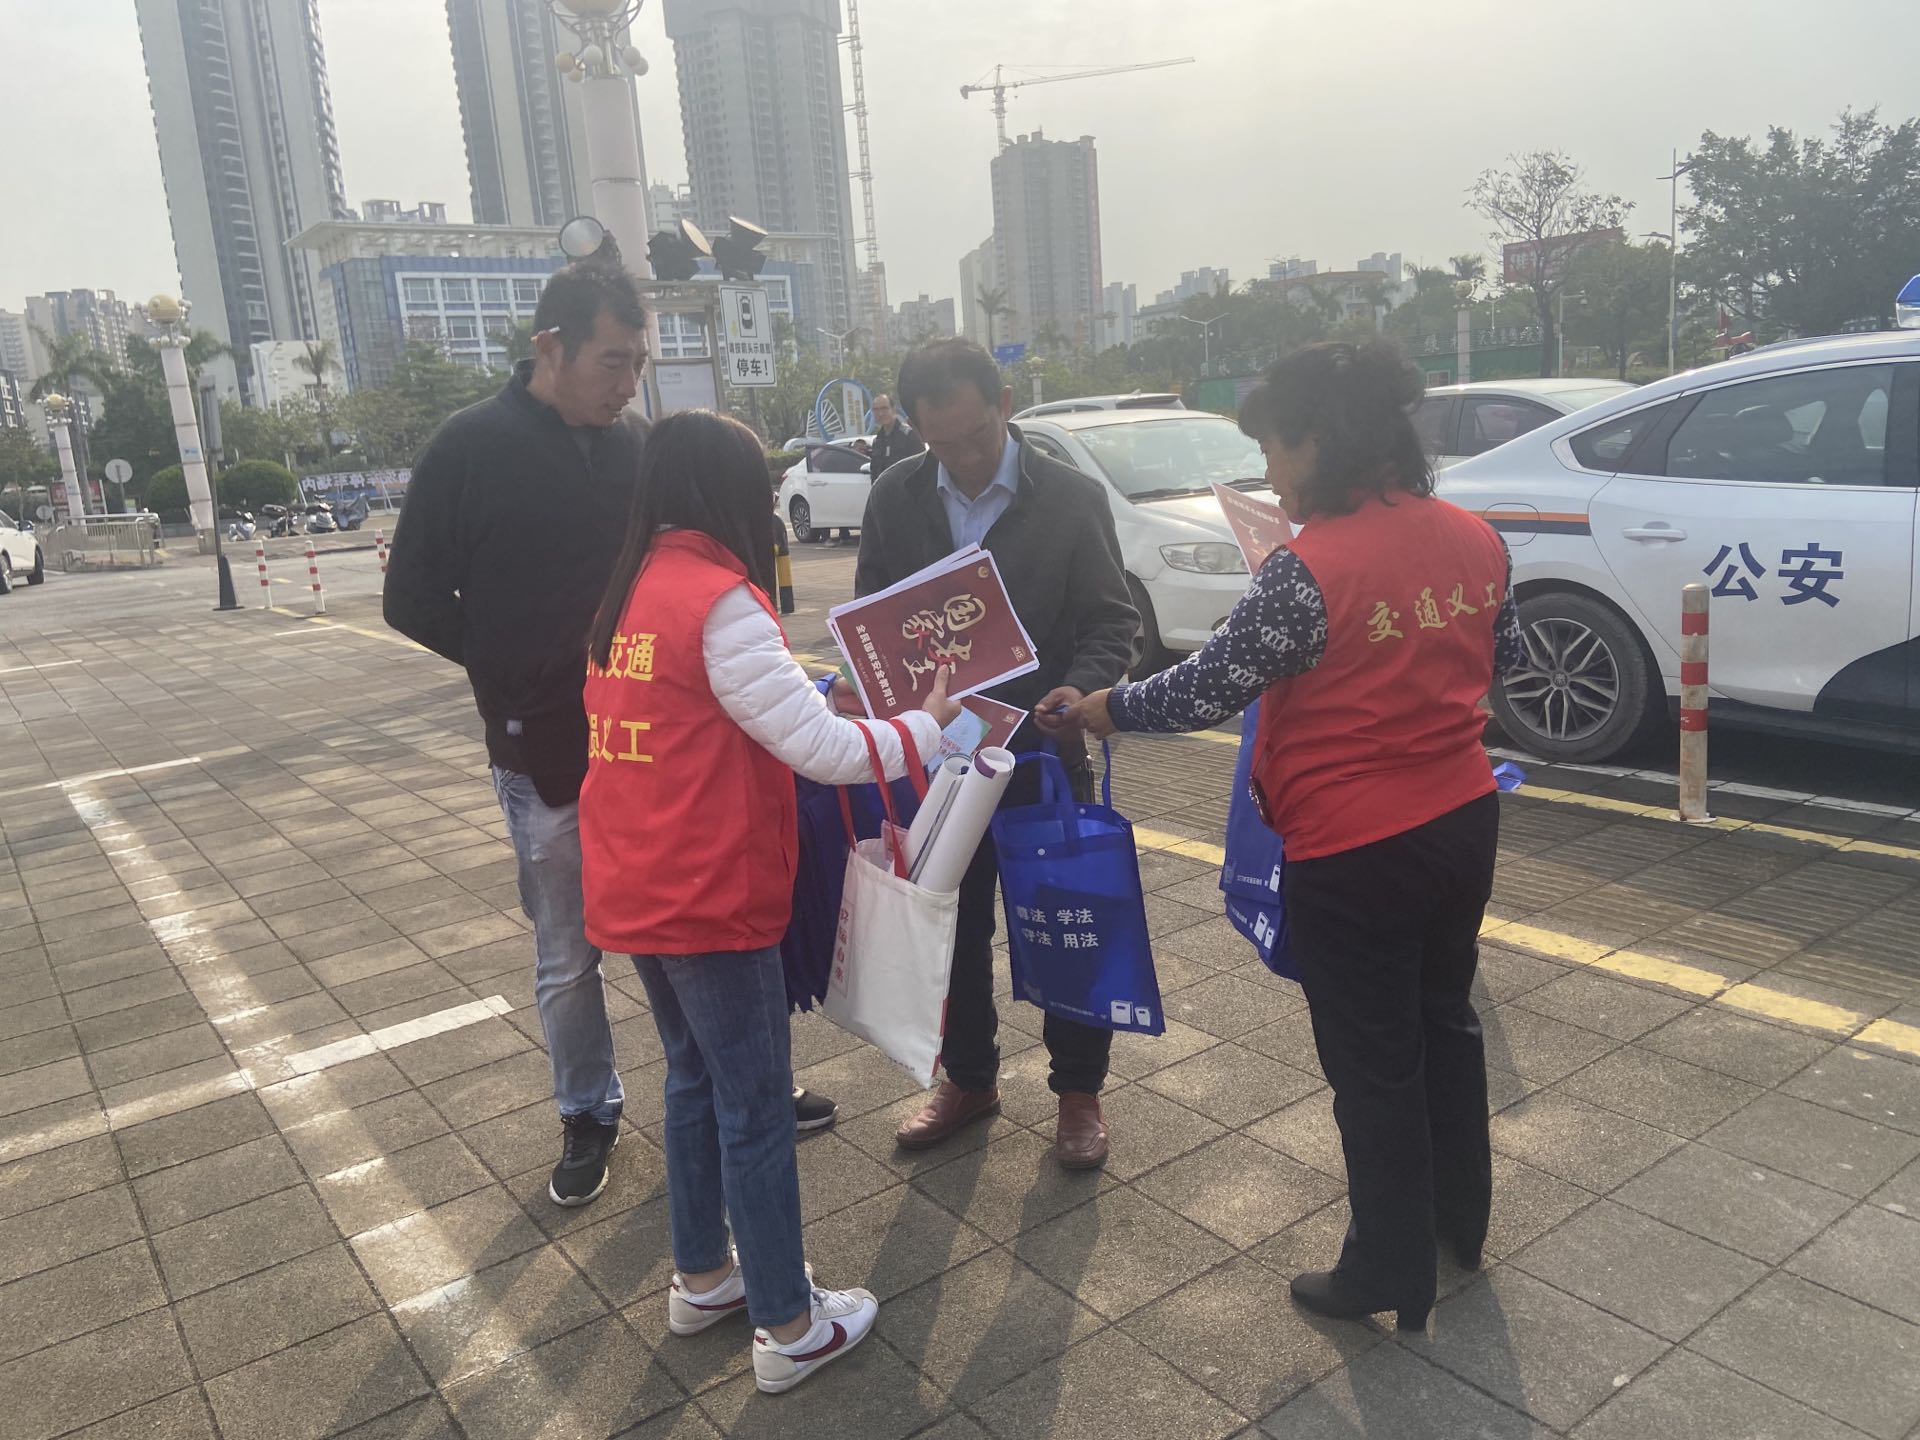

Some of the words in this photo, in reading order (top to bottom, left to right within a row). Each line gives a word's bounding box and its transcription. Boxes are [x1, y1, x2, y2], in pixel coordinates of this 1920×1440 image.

[1703, 542, 1844, 608] 公安
[1367, 582, 1497, 642] 交通义工
[855, 623, 897, 708] 全民国家安全教育日
[1056, 908, 1094, 925] 学法
[1063, 932, 1099, 948] 用法
